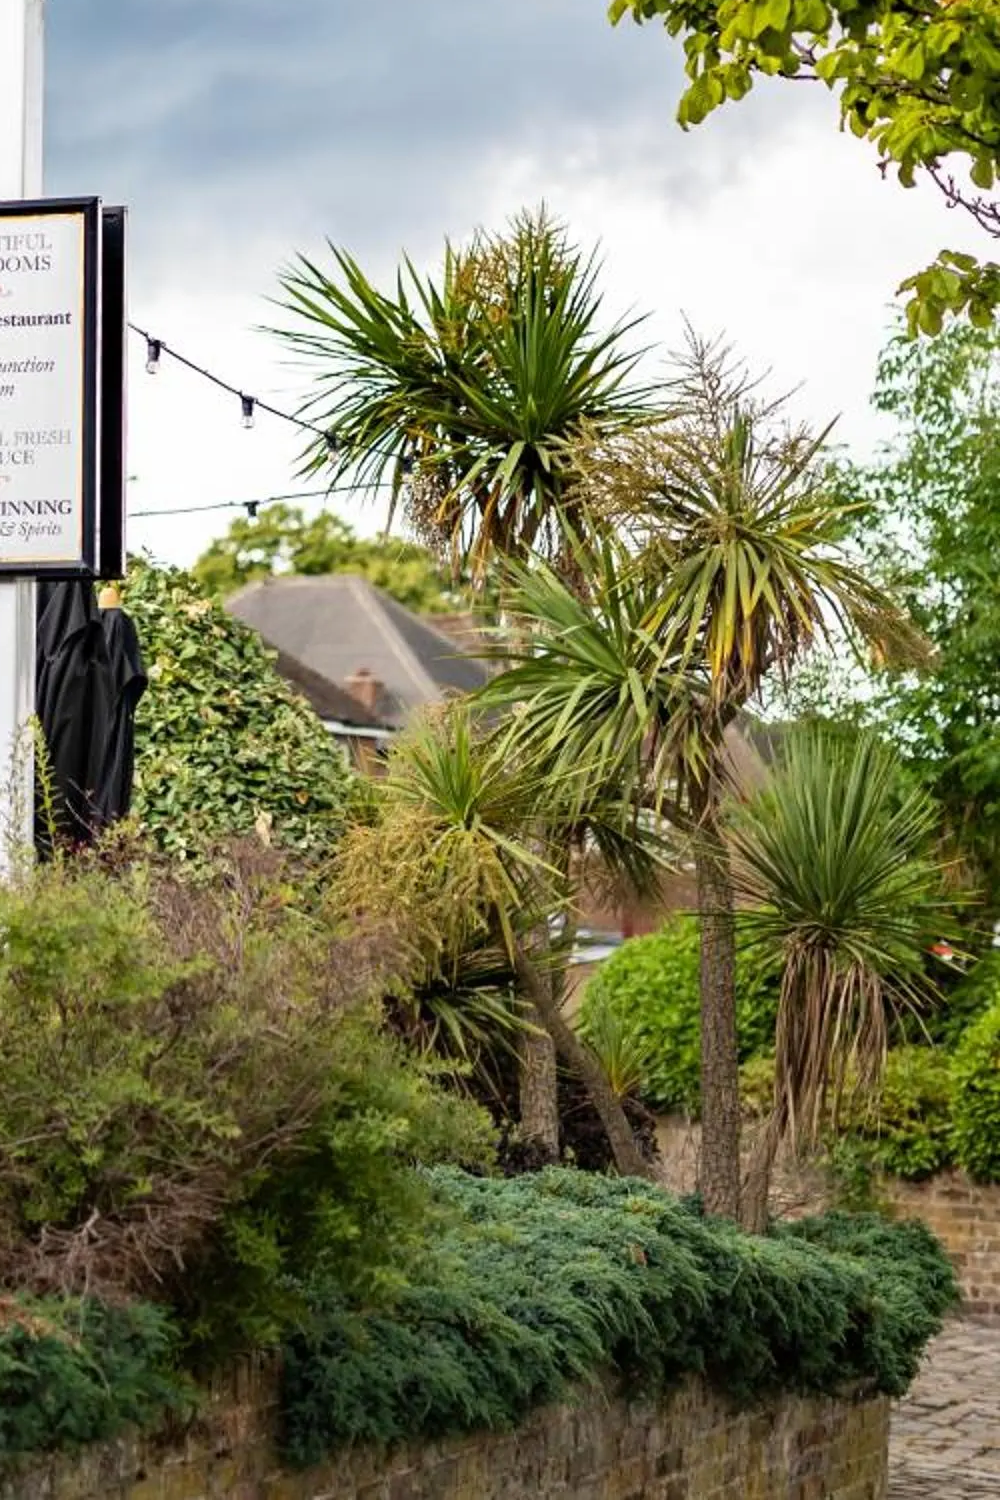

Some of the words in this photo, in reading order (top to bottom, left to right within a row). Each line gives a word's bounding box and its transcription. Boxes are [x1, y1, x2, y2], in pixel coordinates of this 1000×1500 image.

[13, 428, 72, 446] FRESH
[0, 521, 17, 537] &
[18, 521, 63, 542] Spirits
